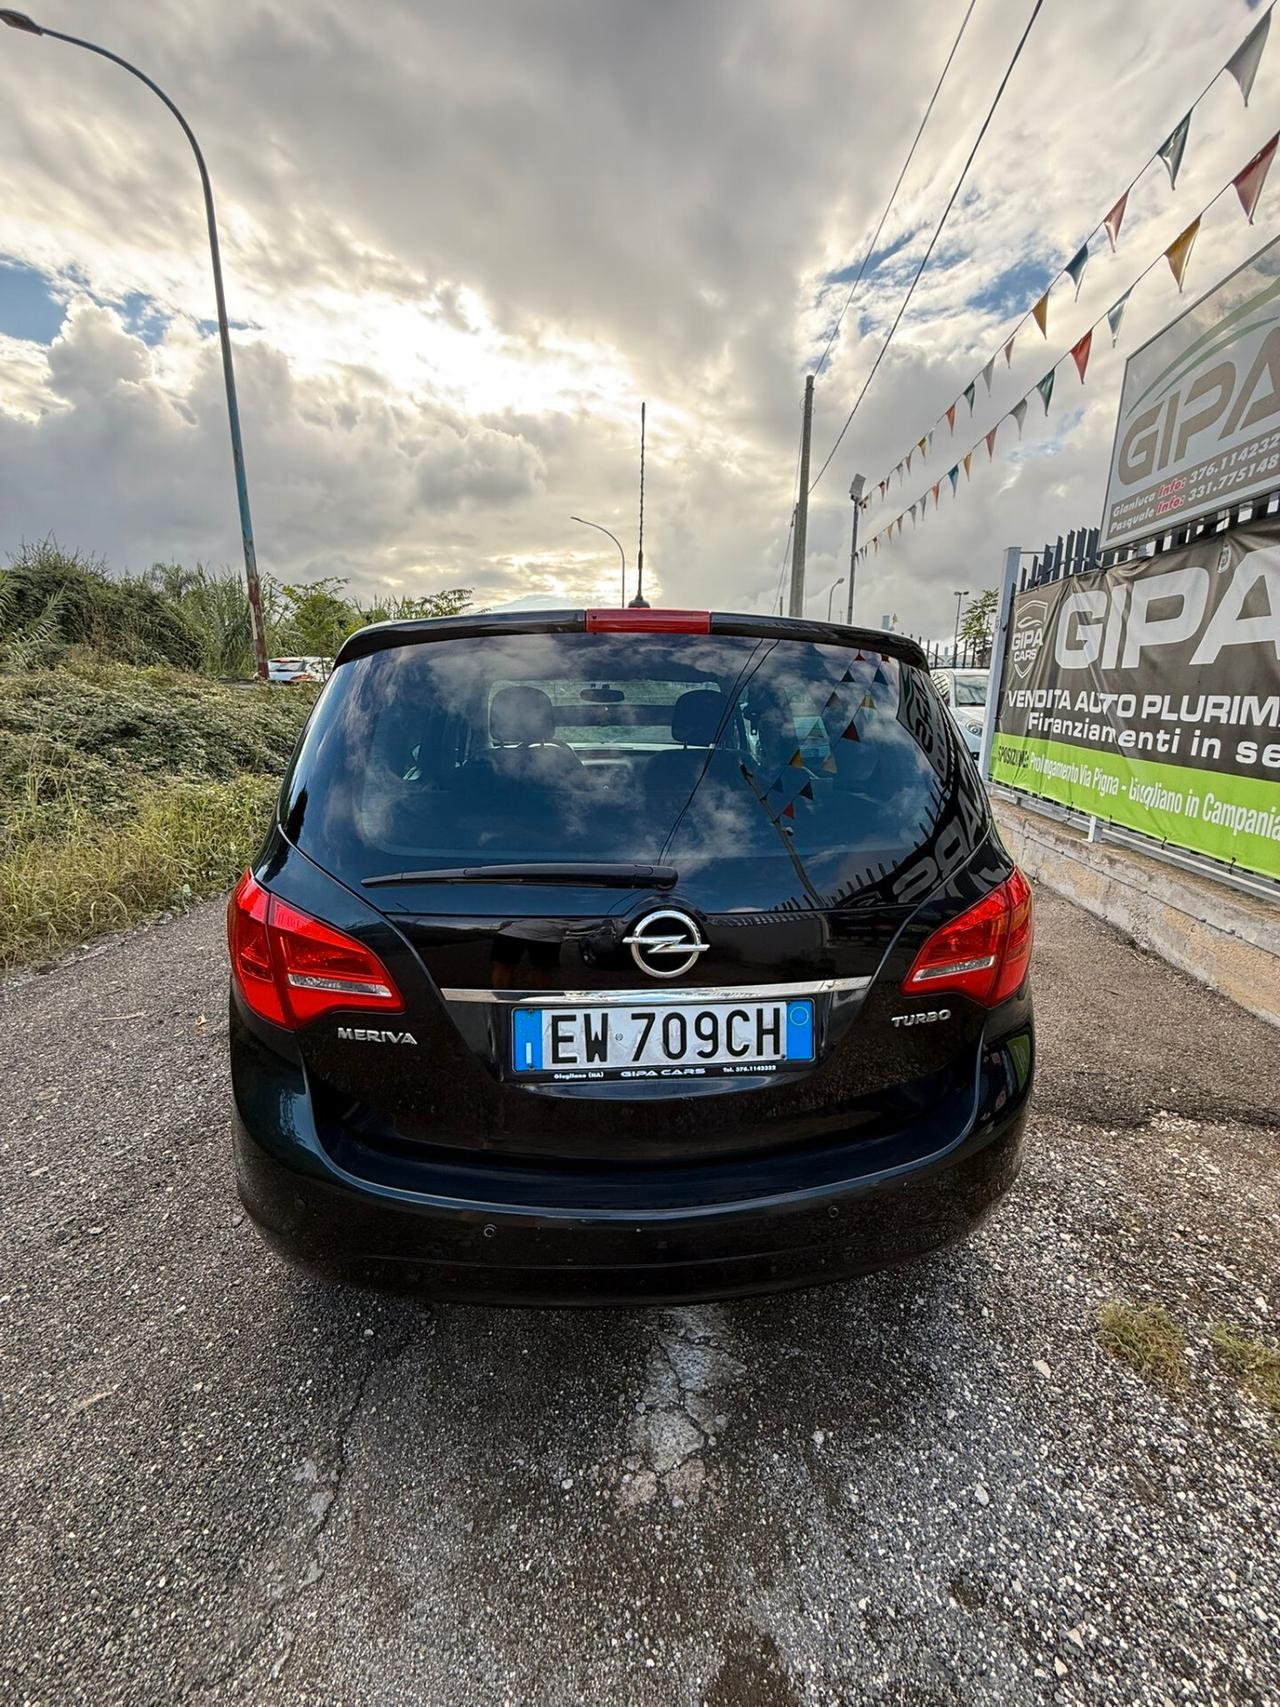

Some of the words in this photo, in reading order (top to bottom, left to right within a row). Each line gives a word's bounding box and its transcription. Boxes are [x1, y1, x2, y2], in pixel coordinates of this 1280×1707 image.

[1110, 507, 1155, 533] Pasquale
[1156, 495, 1186, 516] Info:
[1113, 492, 1156, 517] Gianluca
[1158, 477, 1187, 499] Info:
[1054, 545, 1280, 670] GIPA
[1011, 628, 1044, 651] GIPA
[1014, 648, 1038, 662] CARS
[1008, 689, 1071, 710] VENDITA
[1074, 690, 1137, 718] AUTO
[1141, 695, 1280, 727] PLURIM
[1190, 729, 1222, 760] in
[1080, 764, 1092, 786] Via
[1092, 767, 1119, 796] Pigna
[1185, 788, 1200, 818] in
[1202, 792, 1280, 841] Campania
[891, 1009, 951, 1027] TURBO
[337, 1027, 418, 1045] MERIVA
[551, 1013, 609, 1064] EW
[631, 1007, 781, 1062] 709CH
[620, 1069, 658, 1077] GIPA
[661, 1068, 706, 1076] CARS
